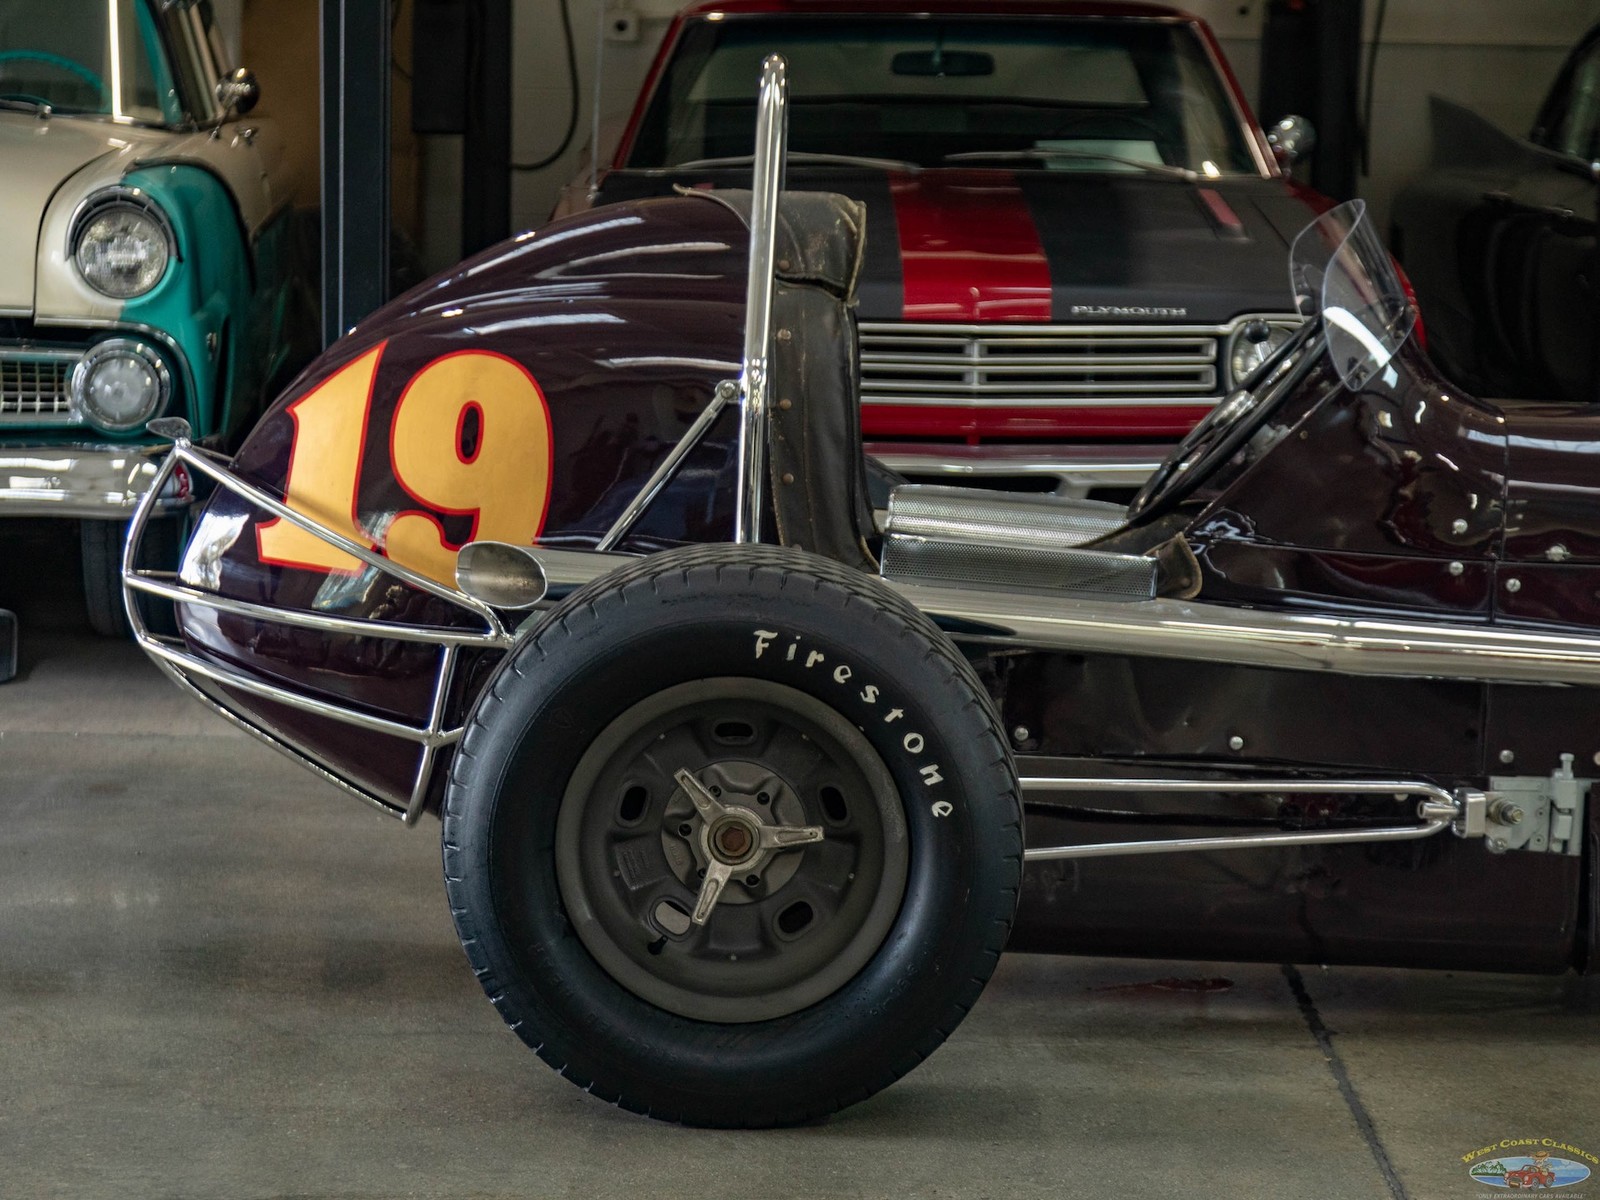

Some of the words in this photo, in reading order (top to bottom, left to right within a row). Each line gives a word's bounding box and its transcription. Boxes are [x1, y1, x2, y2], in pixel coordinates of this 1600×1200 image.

[1071, 305, 1187, 316] PLYMOUTH
[254, 338, 554, 592] 19
[753, 630, 953, 817] Firestone
